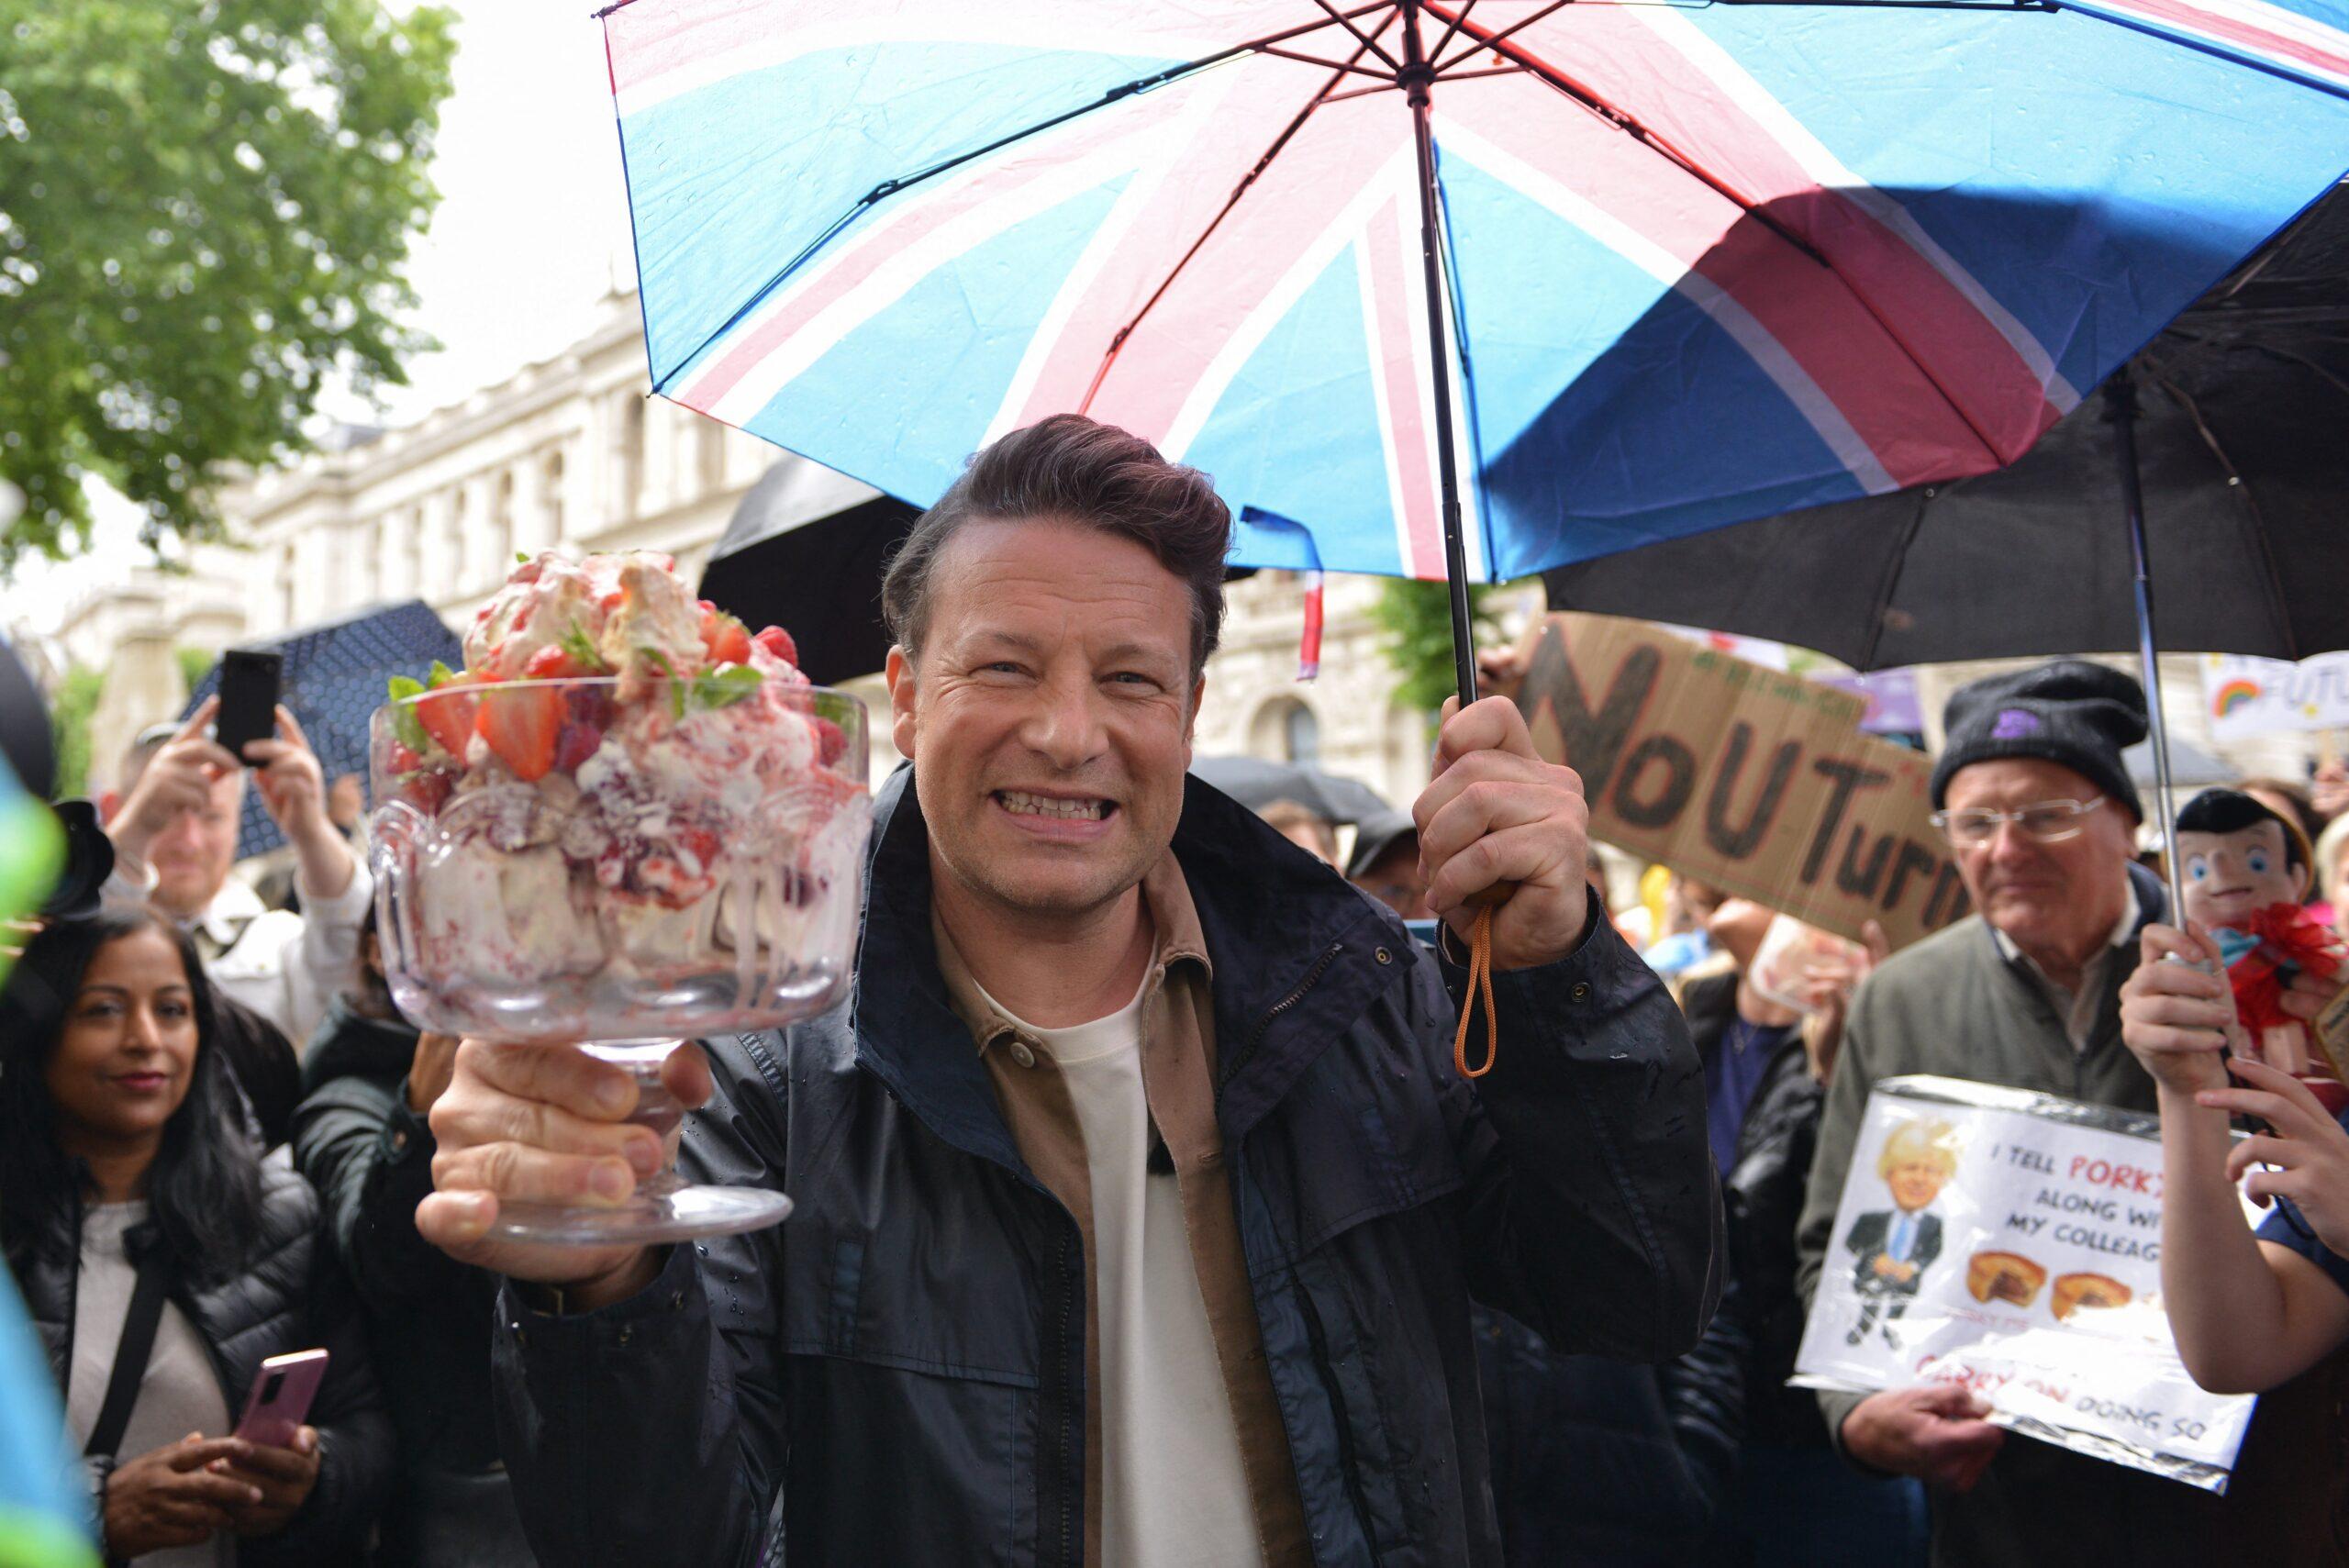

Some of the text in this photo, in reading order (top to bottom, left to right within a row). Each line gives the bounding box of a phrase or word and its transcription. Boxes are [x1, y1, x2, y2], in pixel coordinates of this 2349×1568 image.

[1707, 723, 1802, 861] U
[1990, 1142, 2001, 1160] I
[2009, 1145, 2056, 1176] TELL
[2005, 1212, 2048, 1237] MY
[2034, 1187, 2163, 1229] ALONG WI
[2171, 1418, 2207, 1441] SO
